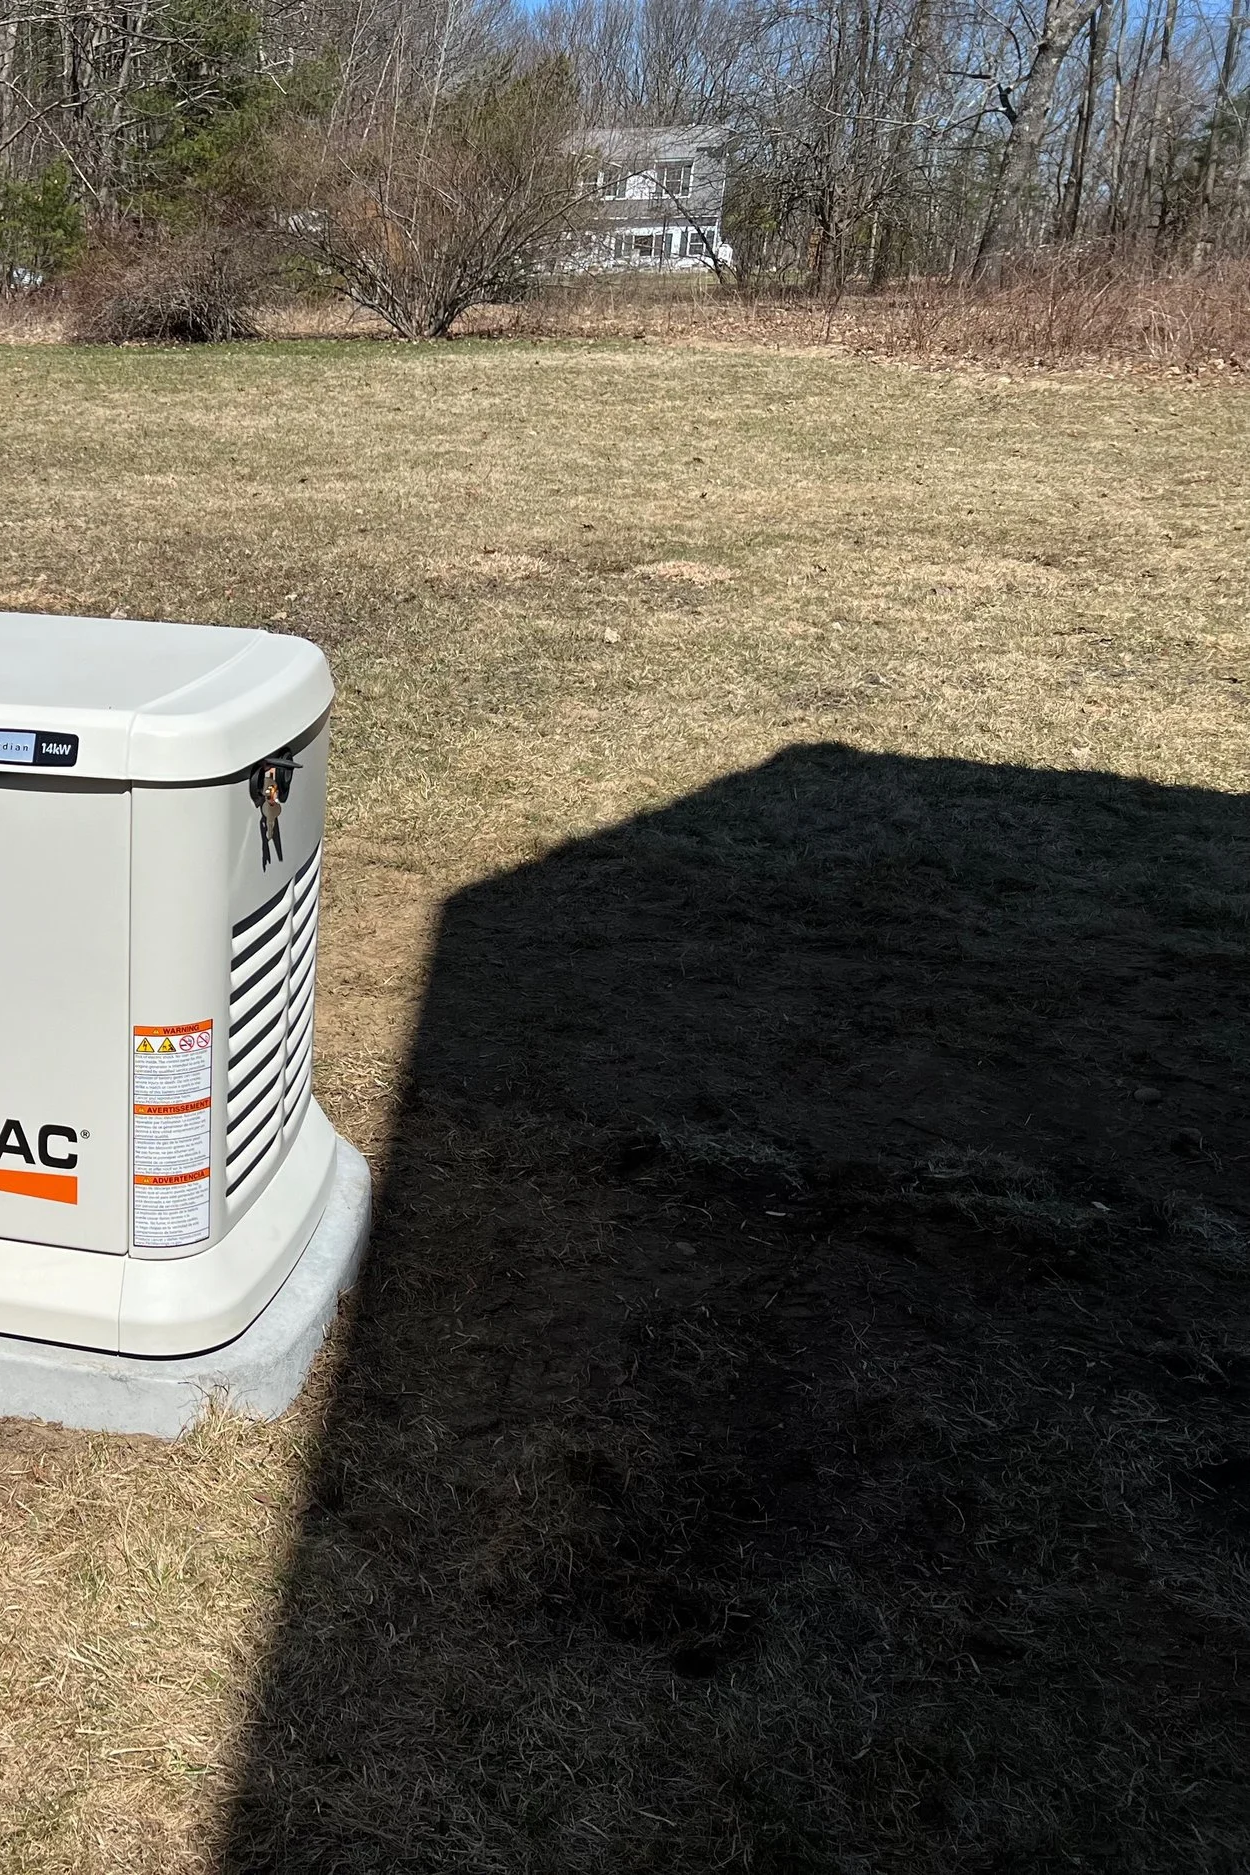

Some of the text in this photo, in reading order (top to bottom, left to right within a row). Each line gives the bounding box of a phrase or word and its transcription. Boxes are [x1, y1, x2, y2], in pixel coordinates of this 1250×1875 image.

[41, 742, 72, 756] 14kW
[163, 1024, 199, 1035] WARNING
[147, 1100, 209, 1113] AVERTISSEMENT
[152, 1171, 205, 1184] ADVERTENCIA
